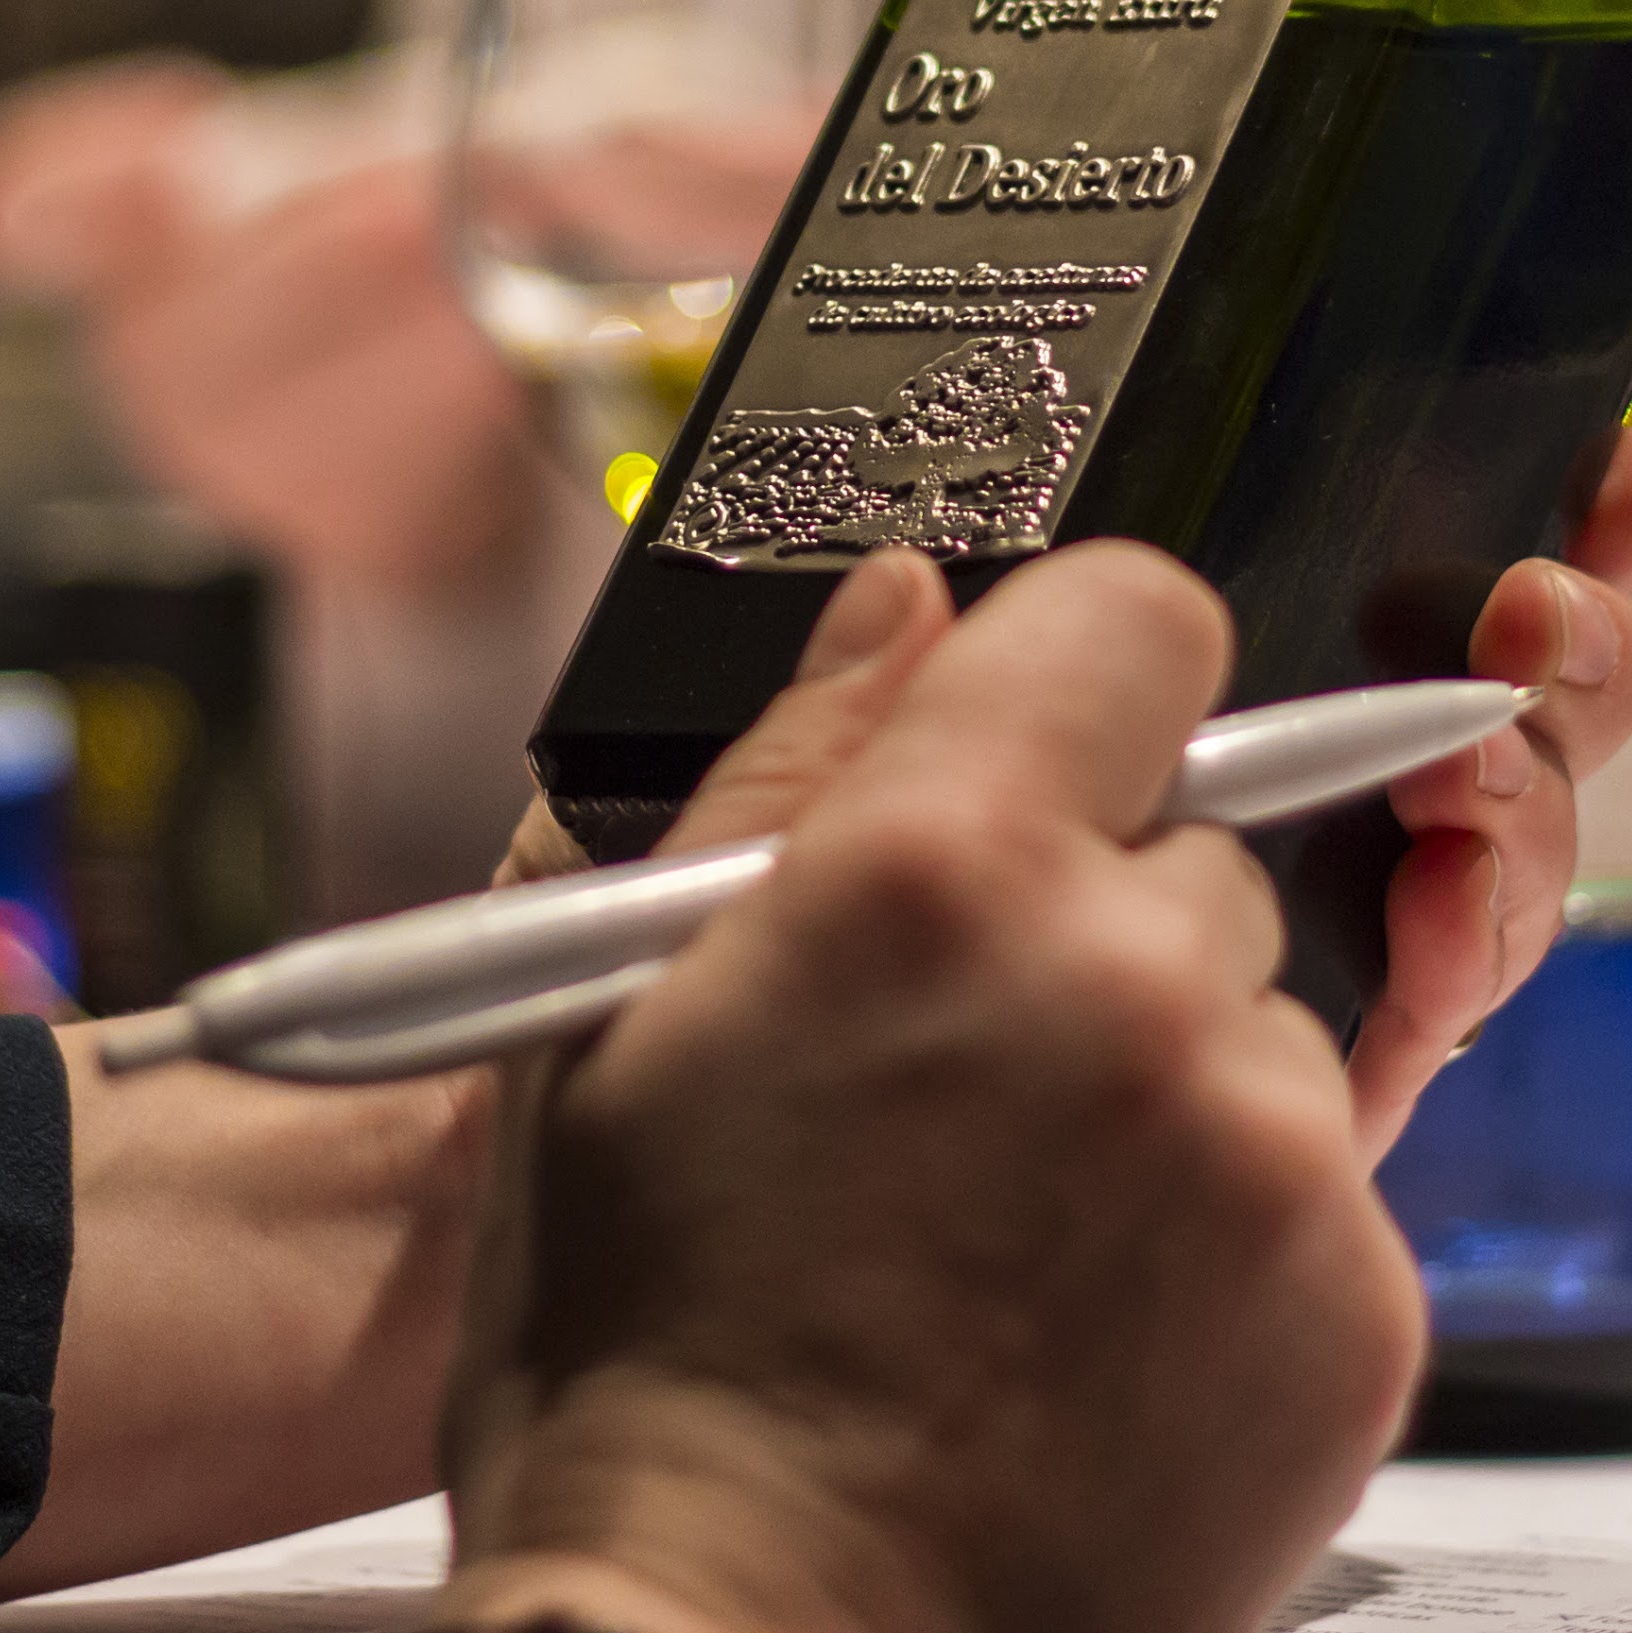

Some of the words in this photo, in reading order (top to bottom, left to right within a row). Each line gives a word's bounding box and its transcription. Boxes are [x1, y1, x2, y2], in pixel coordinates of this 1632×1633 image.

[883, 50, 995, 119] Oro
[841, 142, 944, 212] del
[938, 140, 1196, 210] Desierto
